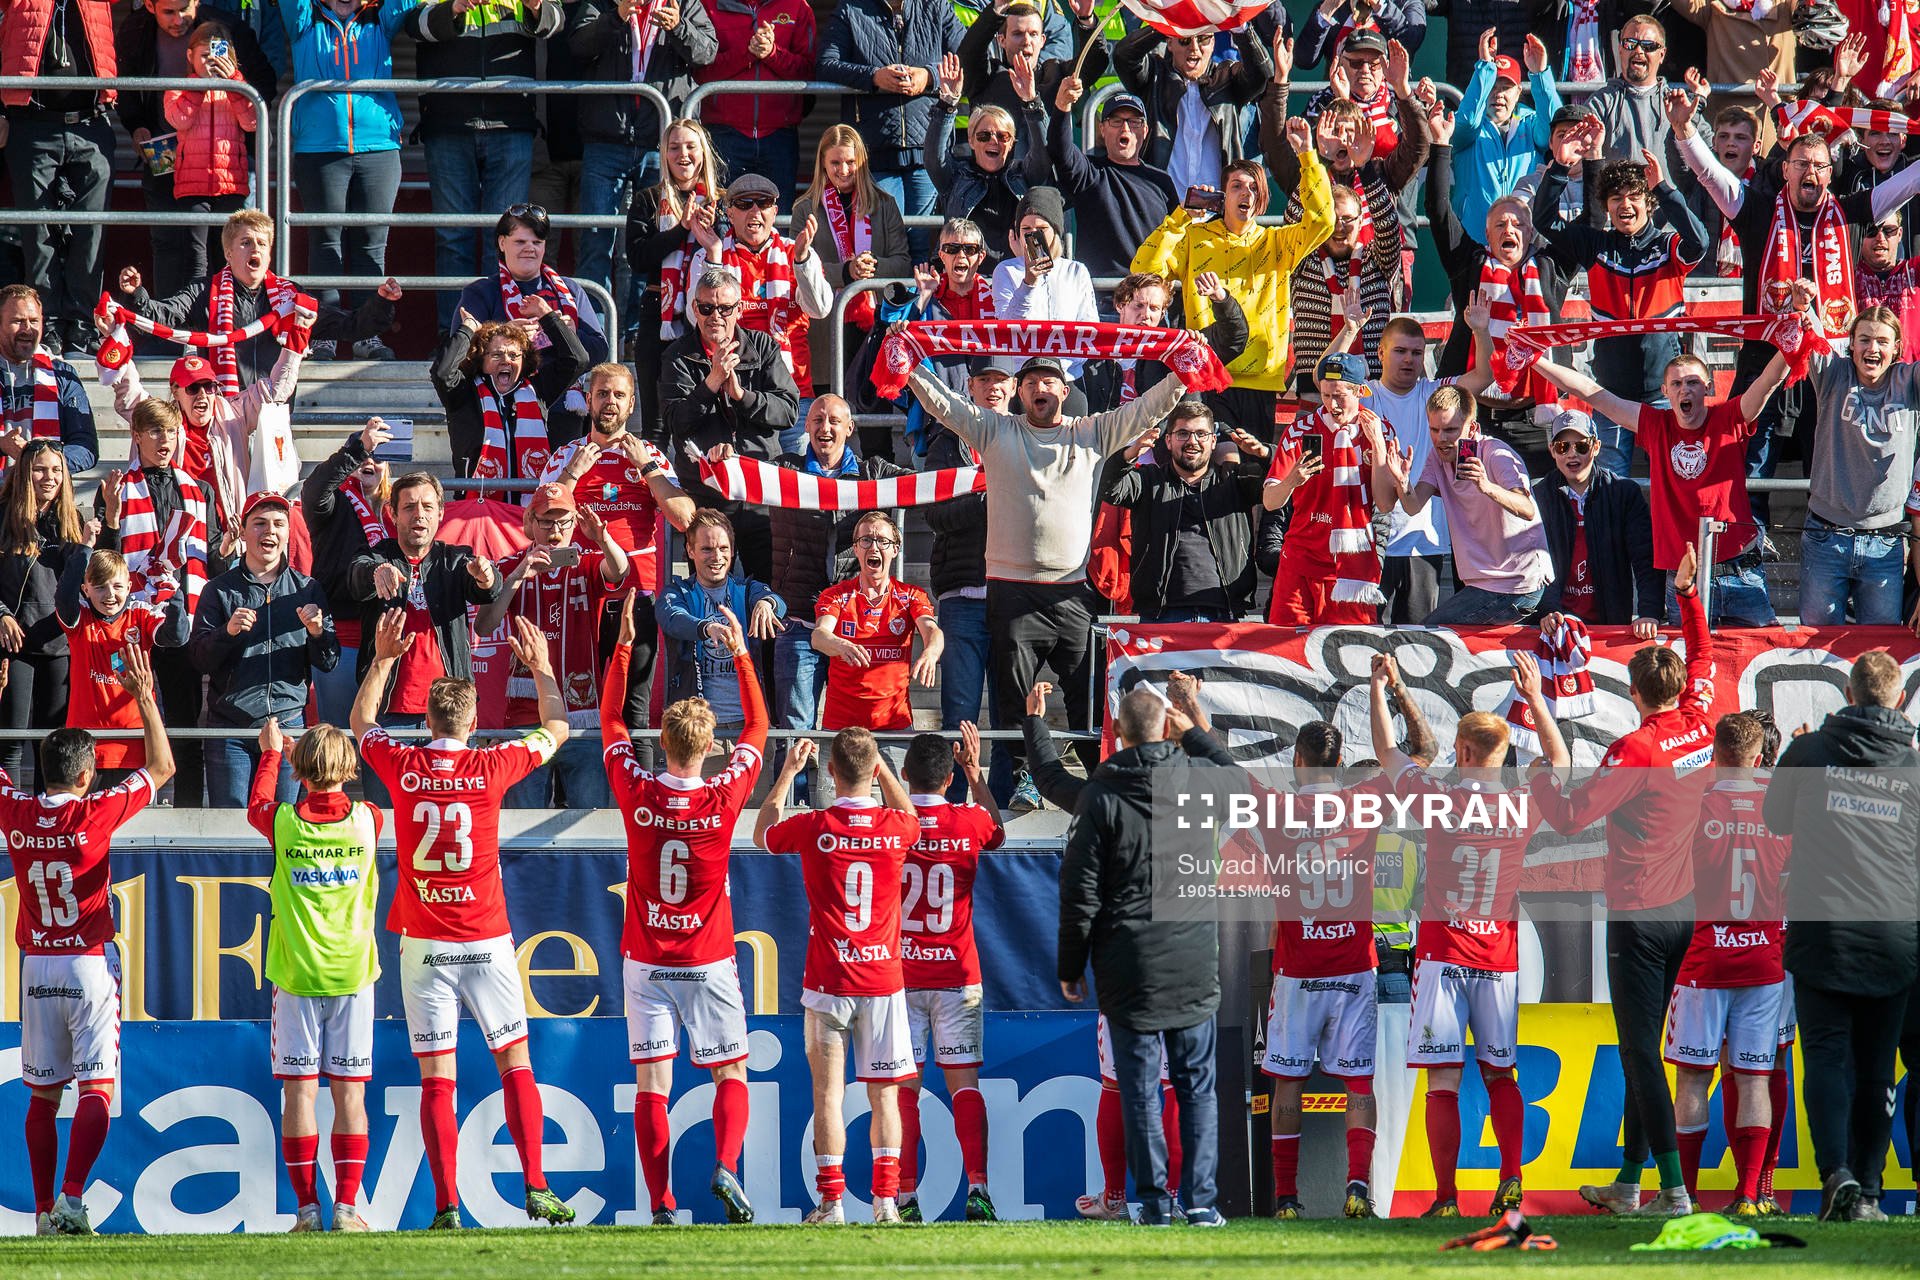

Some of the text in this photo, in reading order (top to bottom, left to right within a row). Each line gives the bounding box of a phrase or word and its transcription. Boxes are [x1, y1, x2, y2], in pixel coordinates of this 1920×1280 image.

[919, 323, 1167, 357] KALMAR FF
[1841, 392, 1909, 434] GANT
[874, 648, 902, 659] VIDEO
[421, 775, 487, 791] REDEYE
[1825, 765, 1910, 793] KALMAR FF
[1830, 794, 1899, 819] YASKAWA
[654, 813, 723, 831] REDEYE
[25, 830, 89, 849] REDEYE
[412, 801, 474, 872] 23
[837, 836, 901, 850] REDEYE
[285, 846, 365, 860] KALMAR FF
[292, 868, 360, 884] YASKAWA
[659, 839, 690, 905] 6
[1295, 836, 1355, 910] 95
[1445, 844, 1501, 916] 31
[1729, 848, 1756, 920] 5
[27, 860, 80, 928] 13
[419, 885, 477, 903] RASTA
[844, 861, 874, 932] 9
[900, 862, 956, 934] 29
[647, 911, 703, 930] RASTA
[1302, 921, 1357, 940] RASTA
[1713, 930, 1770, 948] RASTA
[838, 944, 892, 963] RASTA
[901, 944, 957, 961] RASTA
[414, 1030, 453, 1042] stadium
[486, 1020, 523, 1042] stadium
[632, 1039, 669, 1052] stadium
[695, 1041, 740, 1058] stadium
[938, 1043, 980, 1056] stadium
[1417, 1042, 1460, 1054] stadium
[331, 1055, 371, 1067] stadium
[1269, 1053, 1310, 1068] stadium
